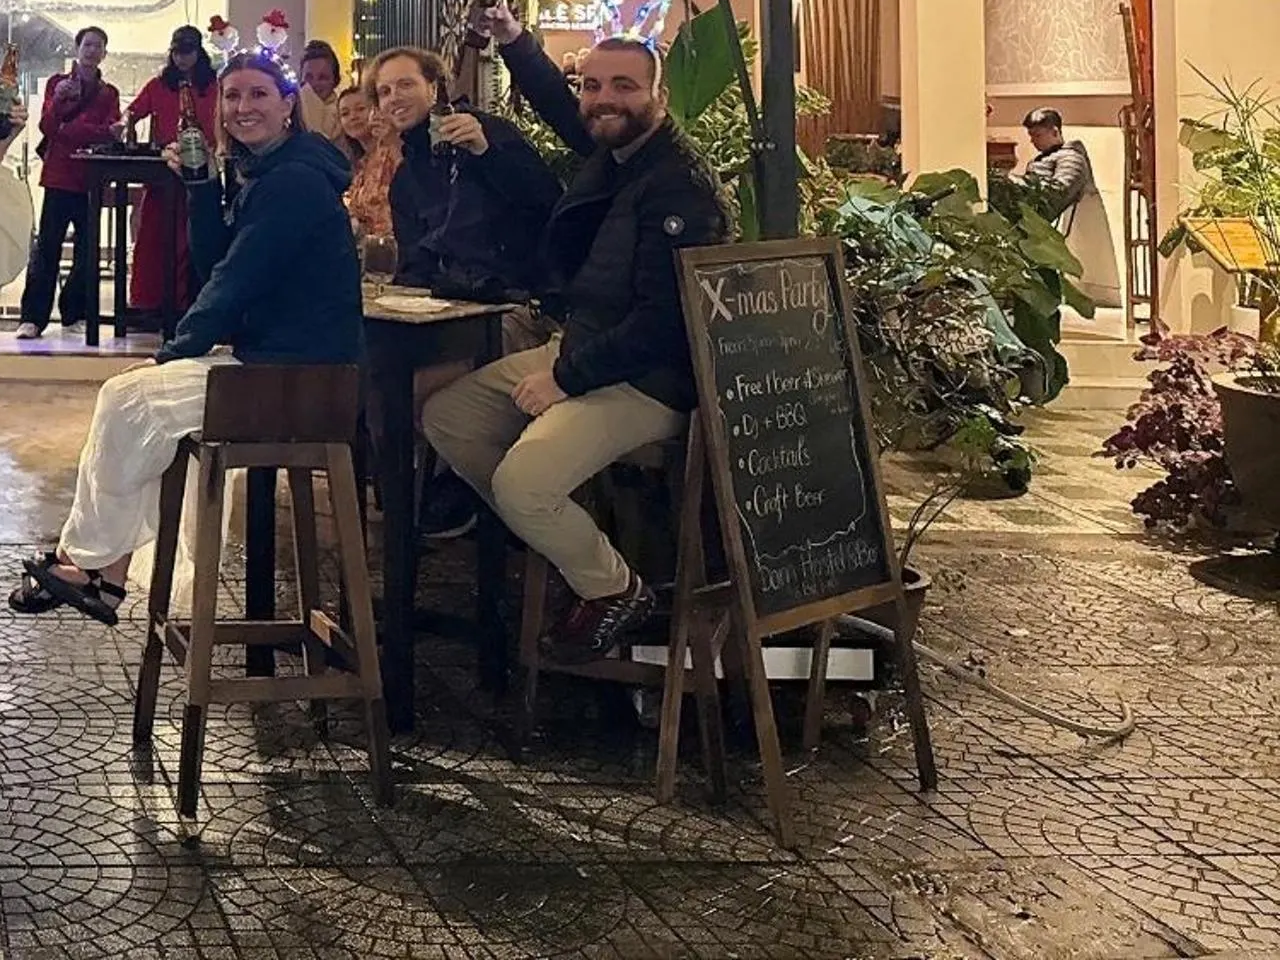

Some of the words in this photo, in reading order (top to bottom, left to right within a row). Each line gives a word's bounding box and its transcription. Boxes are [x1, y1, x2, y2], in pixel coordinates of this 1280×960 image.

[700, 277, 778, 323] X-mas
[780, 268, 833, 335] Party
[735, 374, 763, 401] Free
[776, 401, 808, 430] BBQ
